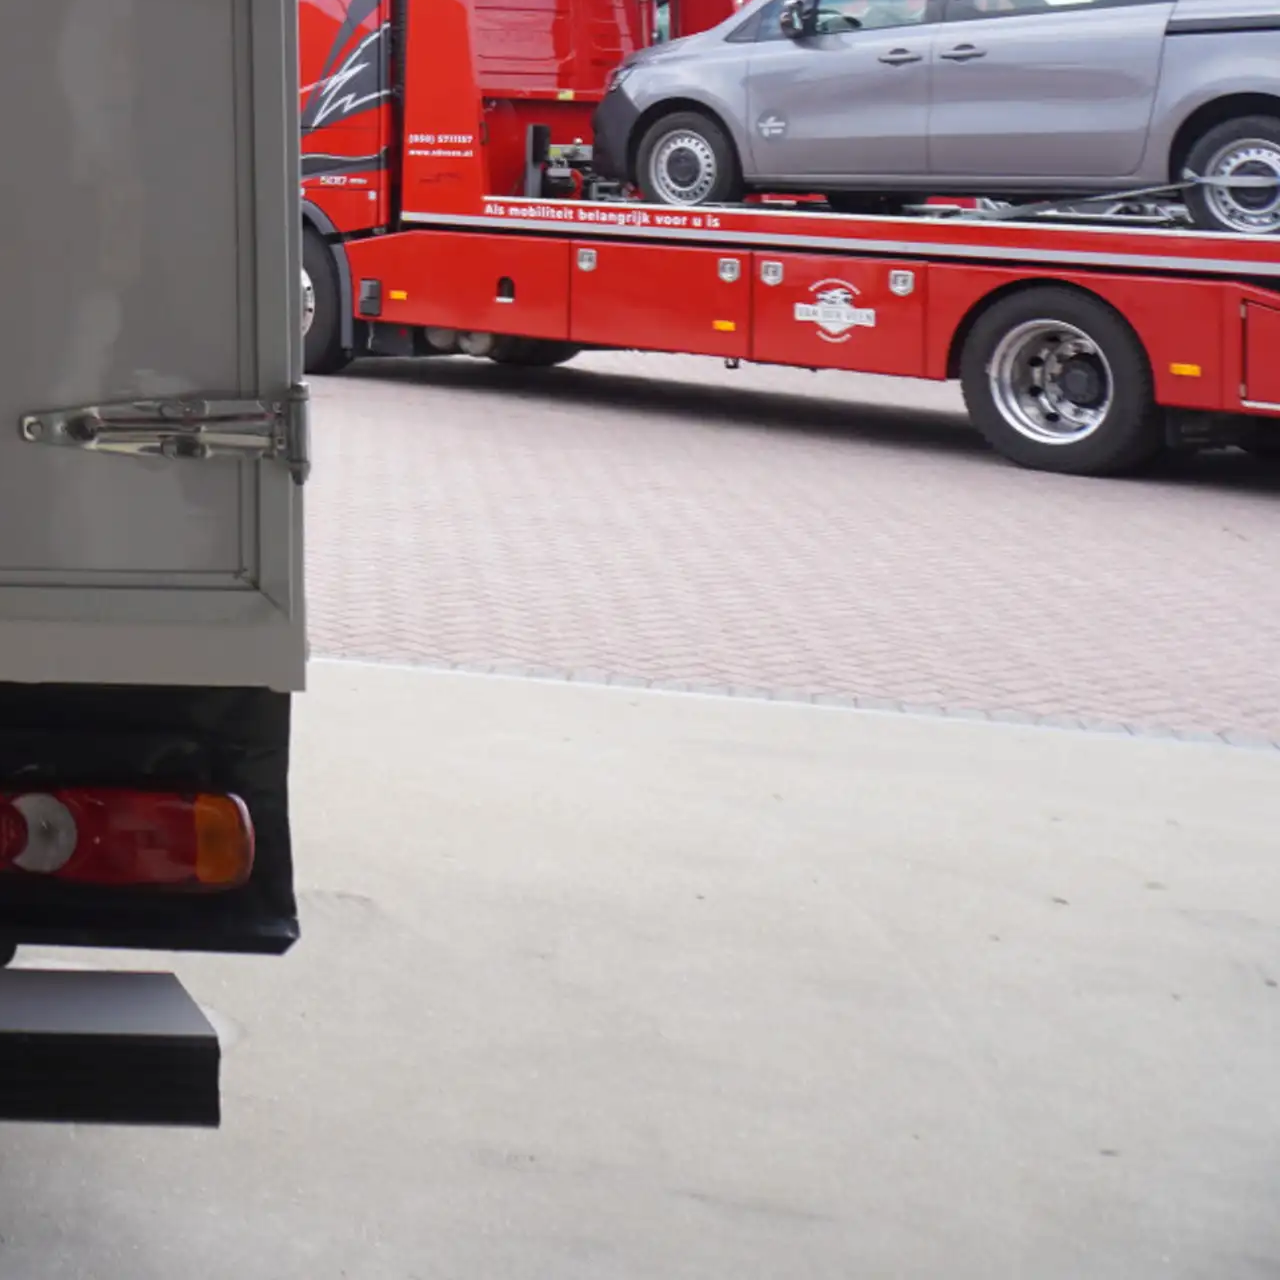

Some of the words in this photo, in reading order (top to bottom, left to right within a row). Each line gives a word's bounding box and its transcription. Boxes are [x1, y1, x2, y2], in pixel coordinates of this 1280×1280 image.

[484, 203, 506, 216] Als
[509, 205, 574, 220] mobiliteit
[578, 208, 651, 226] belangrijk
[654, 215, 688, 226] voor
[691, 217, 701, 227] u
[706, 214, 721, 228] is
